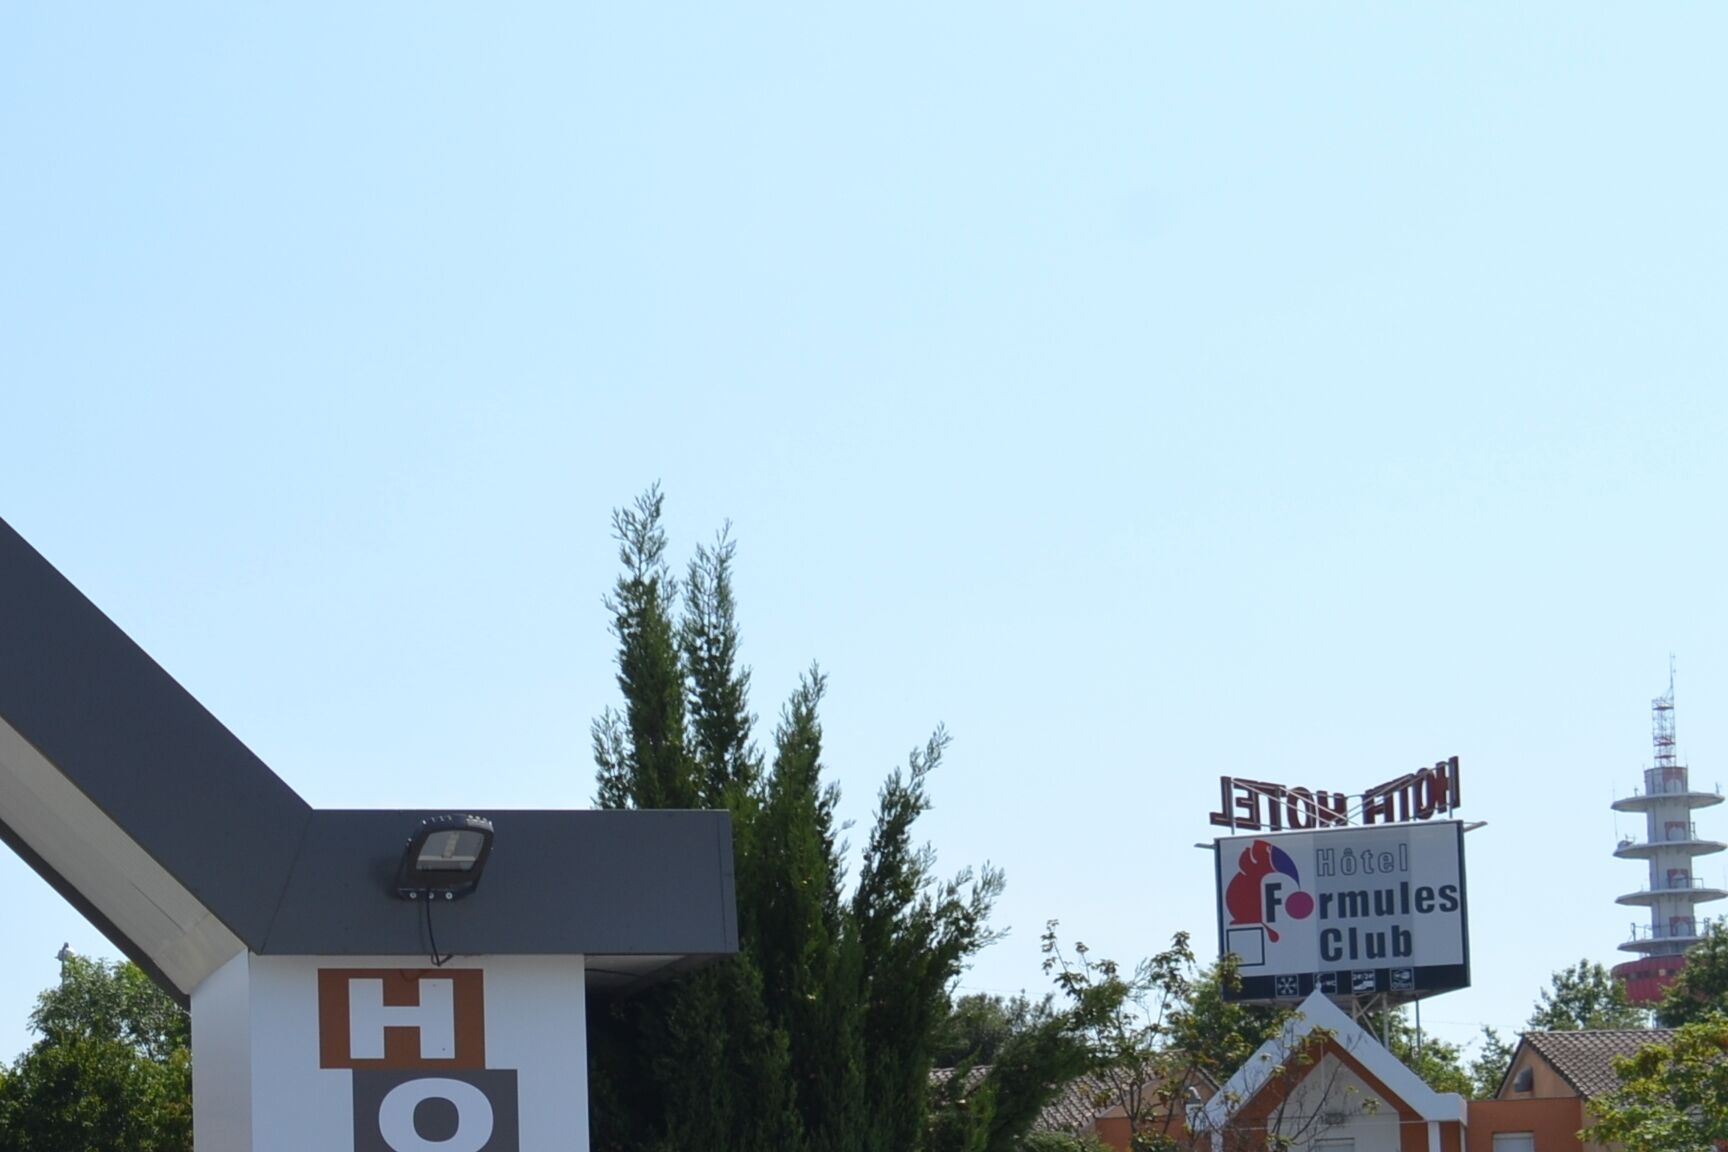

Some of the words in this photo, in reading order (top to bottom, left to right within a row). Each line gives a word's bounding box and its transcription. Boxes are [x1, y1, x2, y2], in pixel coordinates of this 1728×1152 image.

[1316, 843, 1409, 877] Hôtel
[1264, 880, 1460, 924] Formules
[1318, 924, 1414, 962] Club
